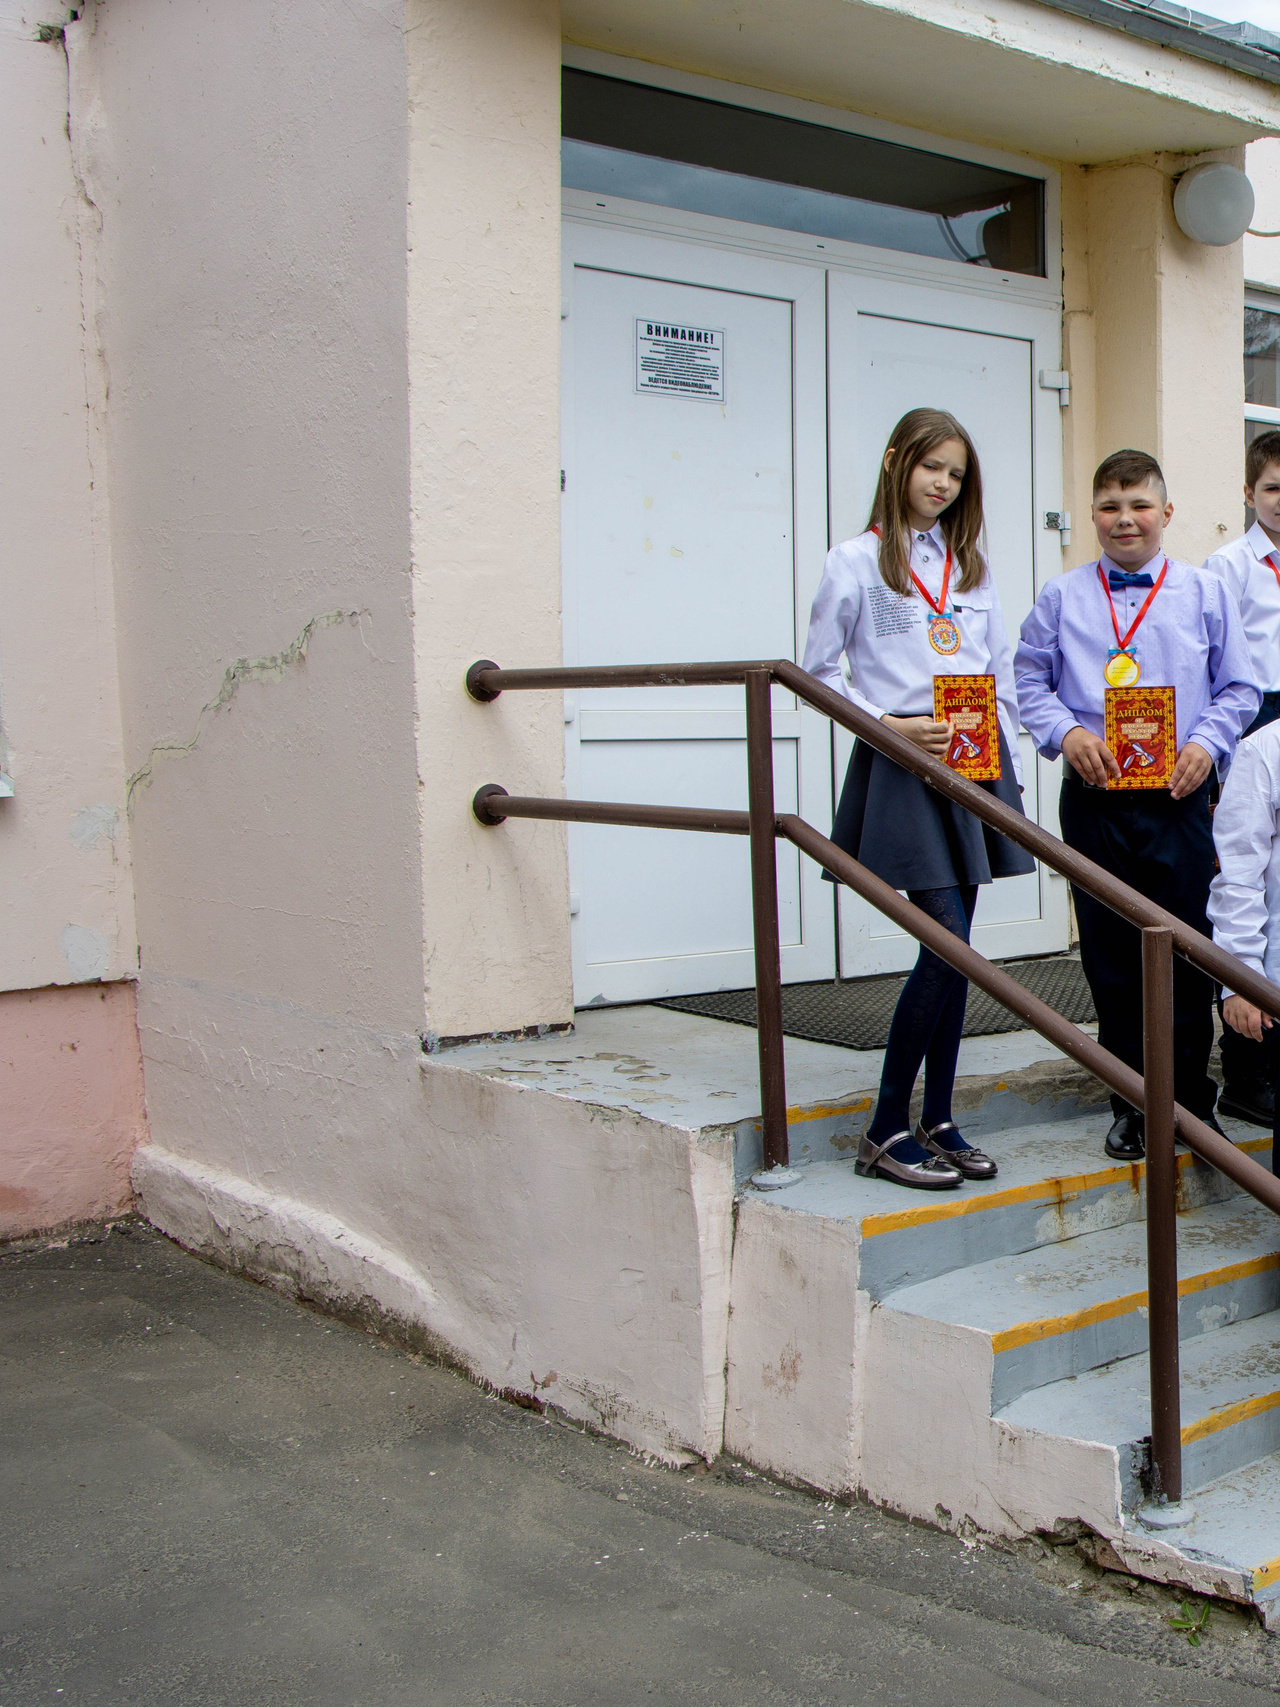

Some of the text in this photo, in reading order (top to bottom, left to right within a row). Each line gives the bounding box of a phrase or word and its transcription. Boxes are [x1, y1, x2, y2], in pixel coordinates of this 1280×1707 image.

[646, 324, 714, 344] ВНИМАНИЕ!
[648, 376, 668, 385] ВЕДЕТСЯ
[668, 379, 712, 390] ВИДЕОНАБЛЮДЕНИЕ
[946, 698, 986, 707] ДИПЛОМ
[1117, 709, 1163, 718] ДИПЛОМ
